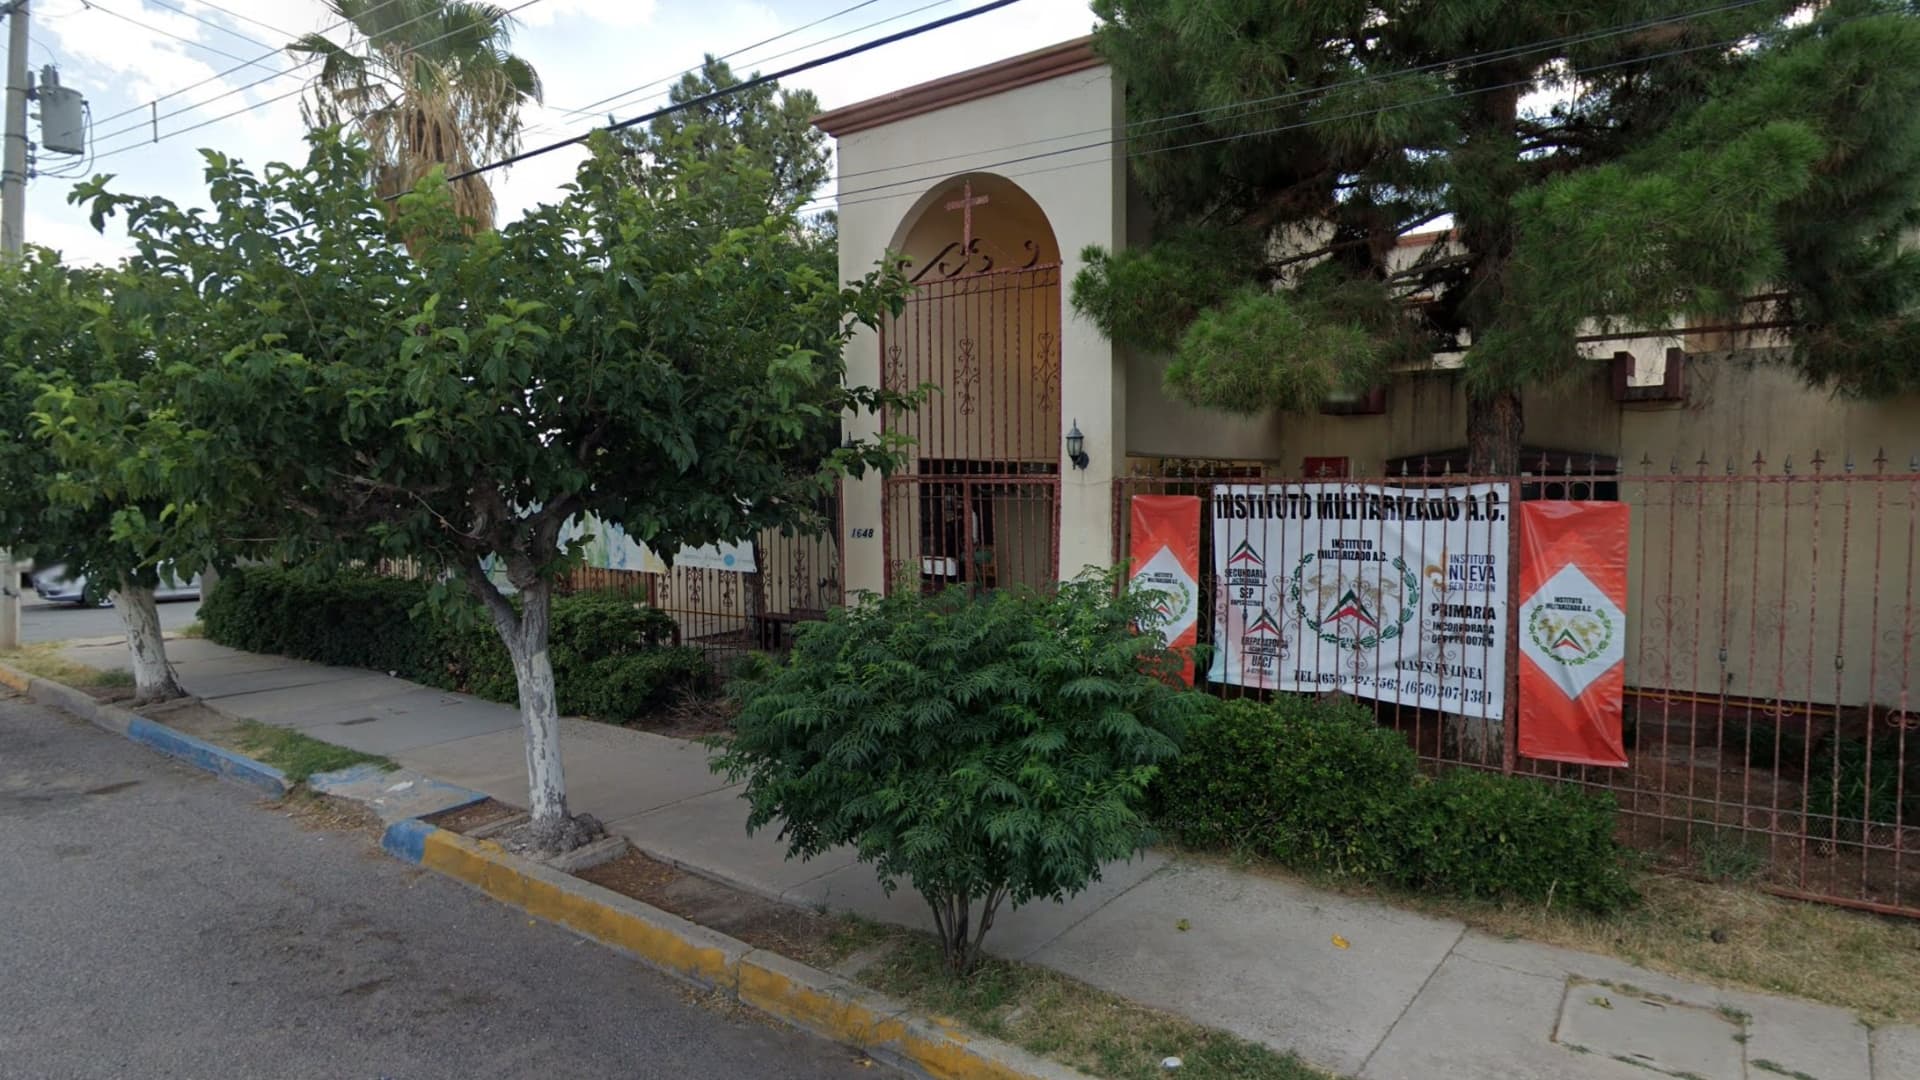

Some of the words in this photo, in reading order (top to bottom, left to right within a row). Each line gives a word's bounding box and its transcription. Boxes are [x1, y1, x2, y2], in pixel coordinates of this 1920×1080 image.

[1216, 493, 1312, 520] INSTITUTO
[1317, 492, 1460, 521] MILITARIZADO
[1464, 490, 1506, 522] A.C.
[851, 527, 874, 538] 1648
[1317, 549, 1371, 561] MILITRIZADO
[1450, 554, 1496, 565] INSTITUTO
[1449, 565, 1496, 582] NUEVA
[1240, 587, 1254, 599] SEP
[1431, 603, 1497, 621] PRIMARIA
